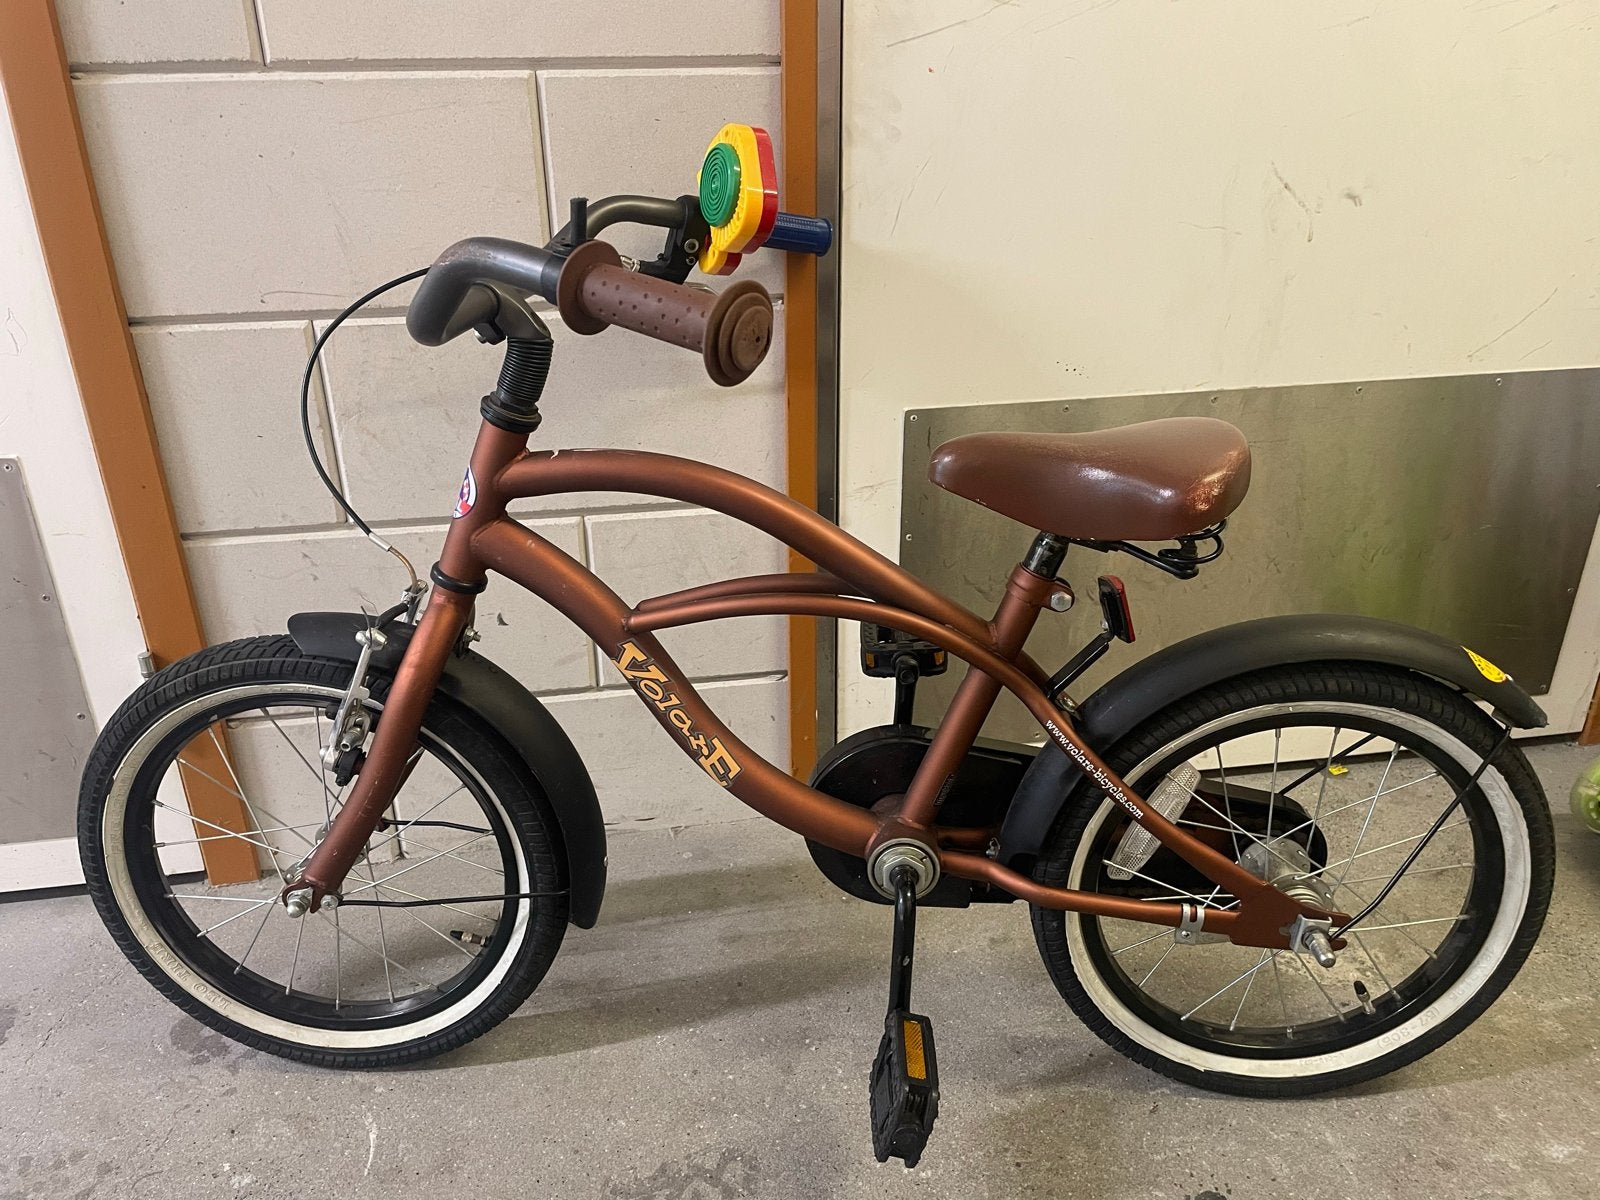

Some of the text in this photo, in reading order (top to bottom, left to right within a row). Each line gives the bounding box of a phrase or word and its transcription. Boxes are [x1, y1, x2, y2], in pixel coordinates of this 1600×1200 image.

[1045, 719, 1144, 819] www.volare-bicycles.com
[149, 941, 232, 1010] LEO TIRE
